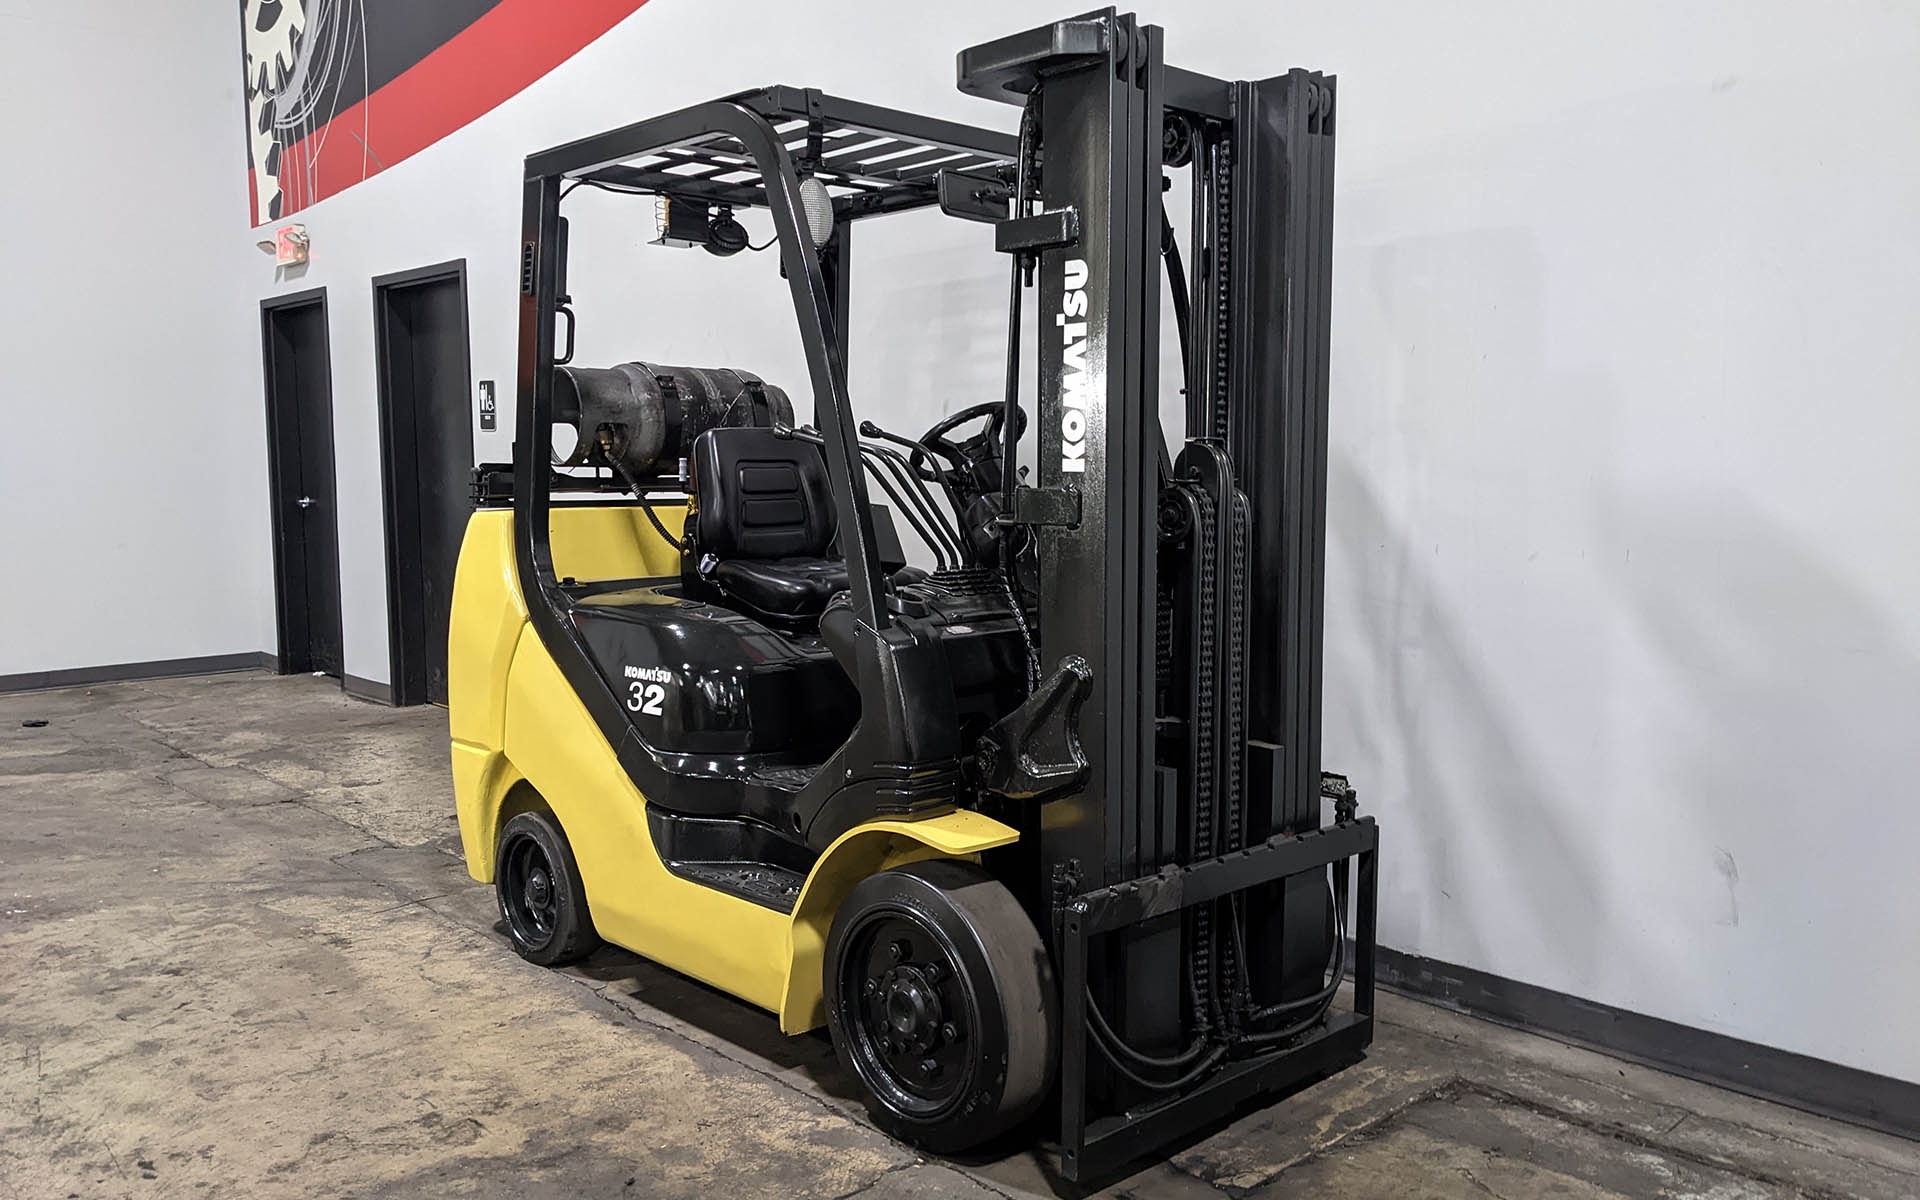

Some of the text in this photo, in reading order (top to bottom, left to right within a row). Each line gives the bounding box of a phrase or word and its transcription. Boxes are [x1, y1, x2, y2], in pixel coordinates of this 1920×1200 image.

[1056, 259, 1089, 473] KOMATSU
[624, 665, 672, 684] KOMATSU
[627, 681, 665, 717] 32
